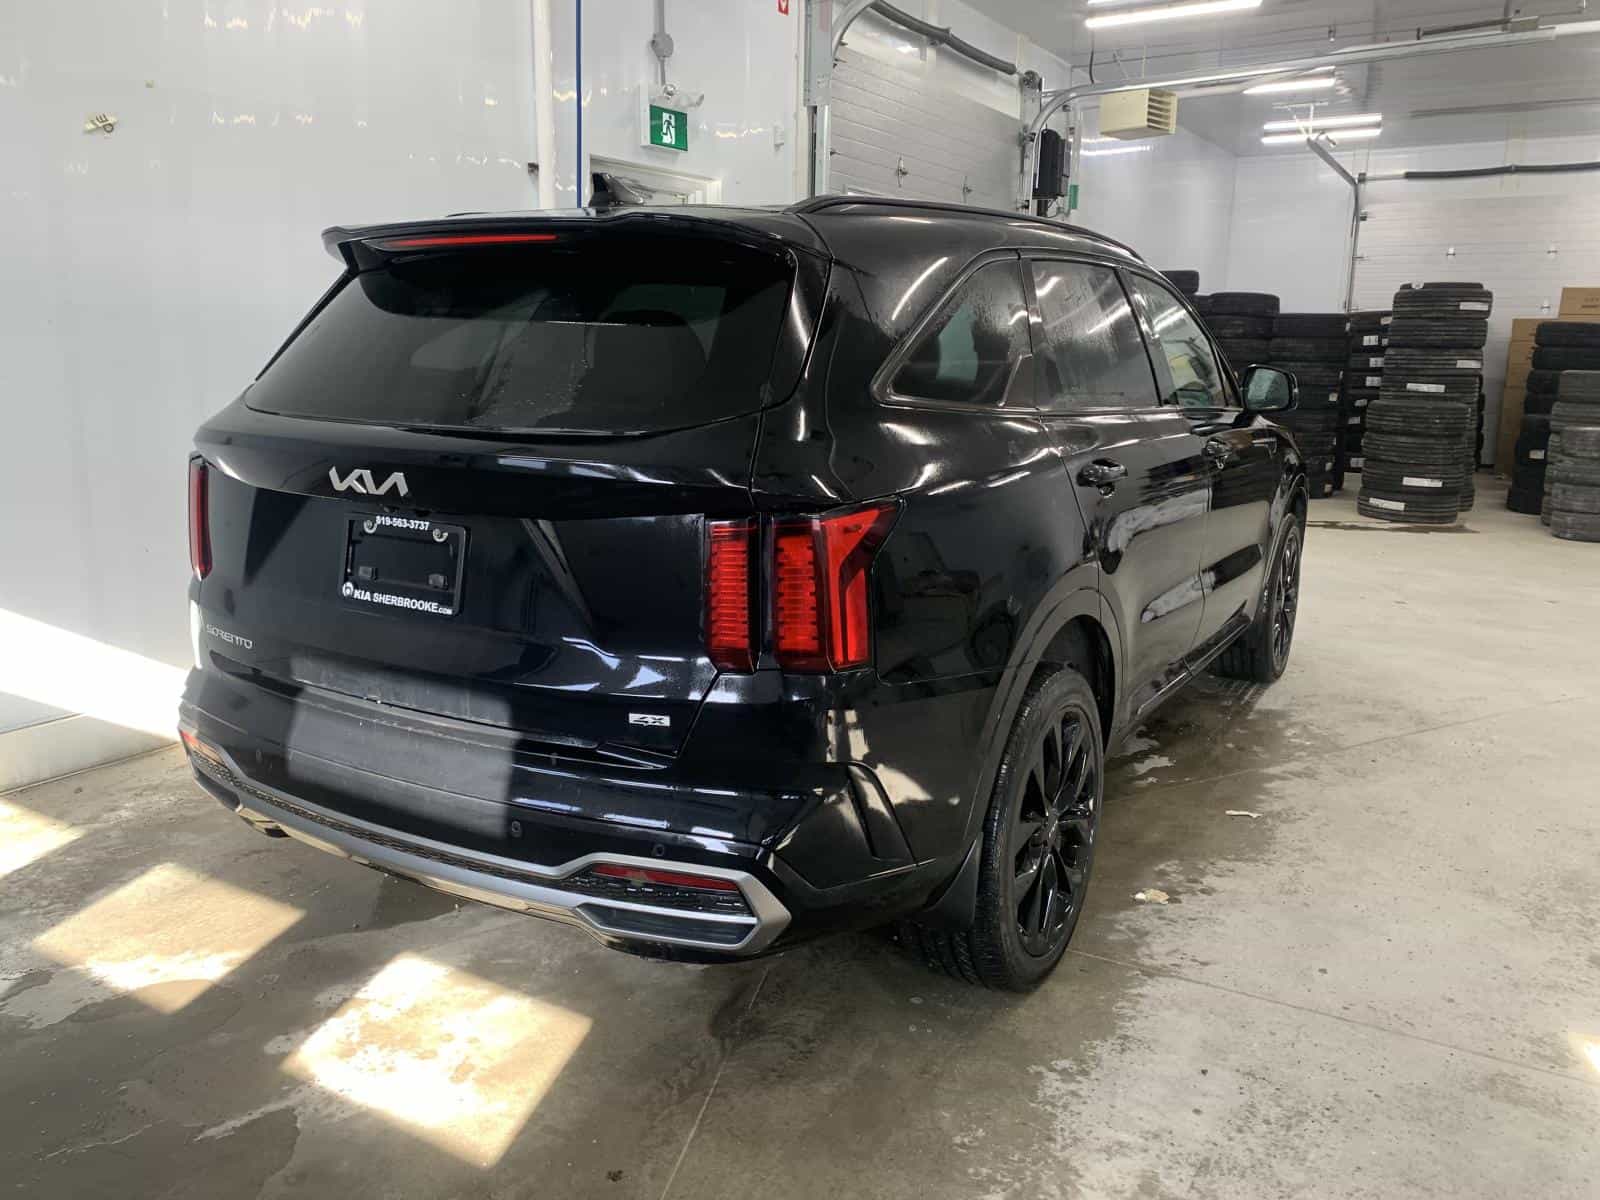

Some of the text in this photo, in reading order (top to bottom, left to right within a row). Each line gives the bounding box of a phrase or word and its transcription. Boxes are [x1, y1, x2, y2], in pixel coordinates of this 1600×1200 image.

[328, 465, 409, 497] KIA
[375, 515, 430, 531] 819-563-3737
[353, 589, 372, 602] KIA
